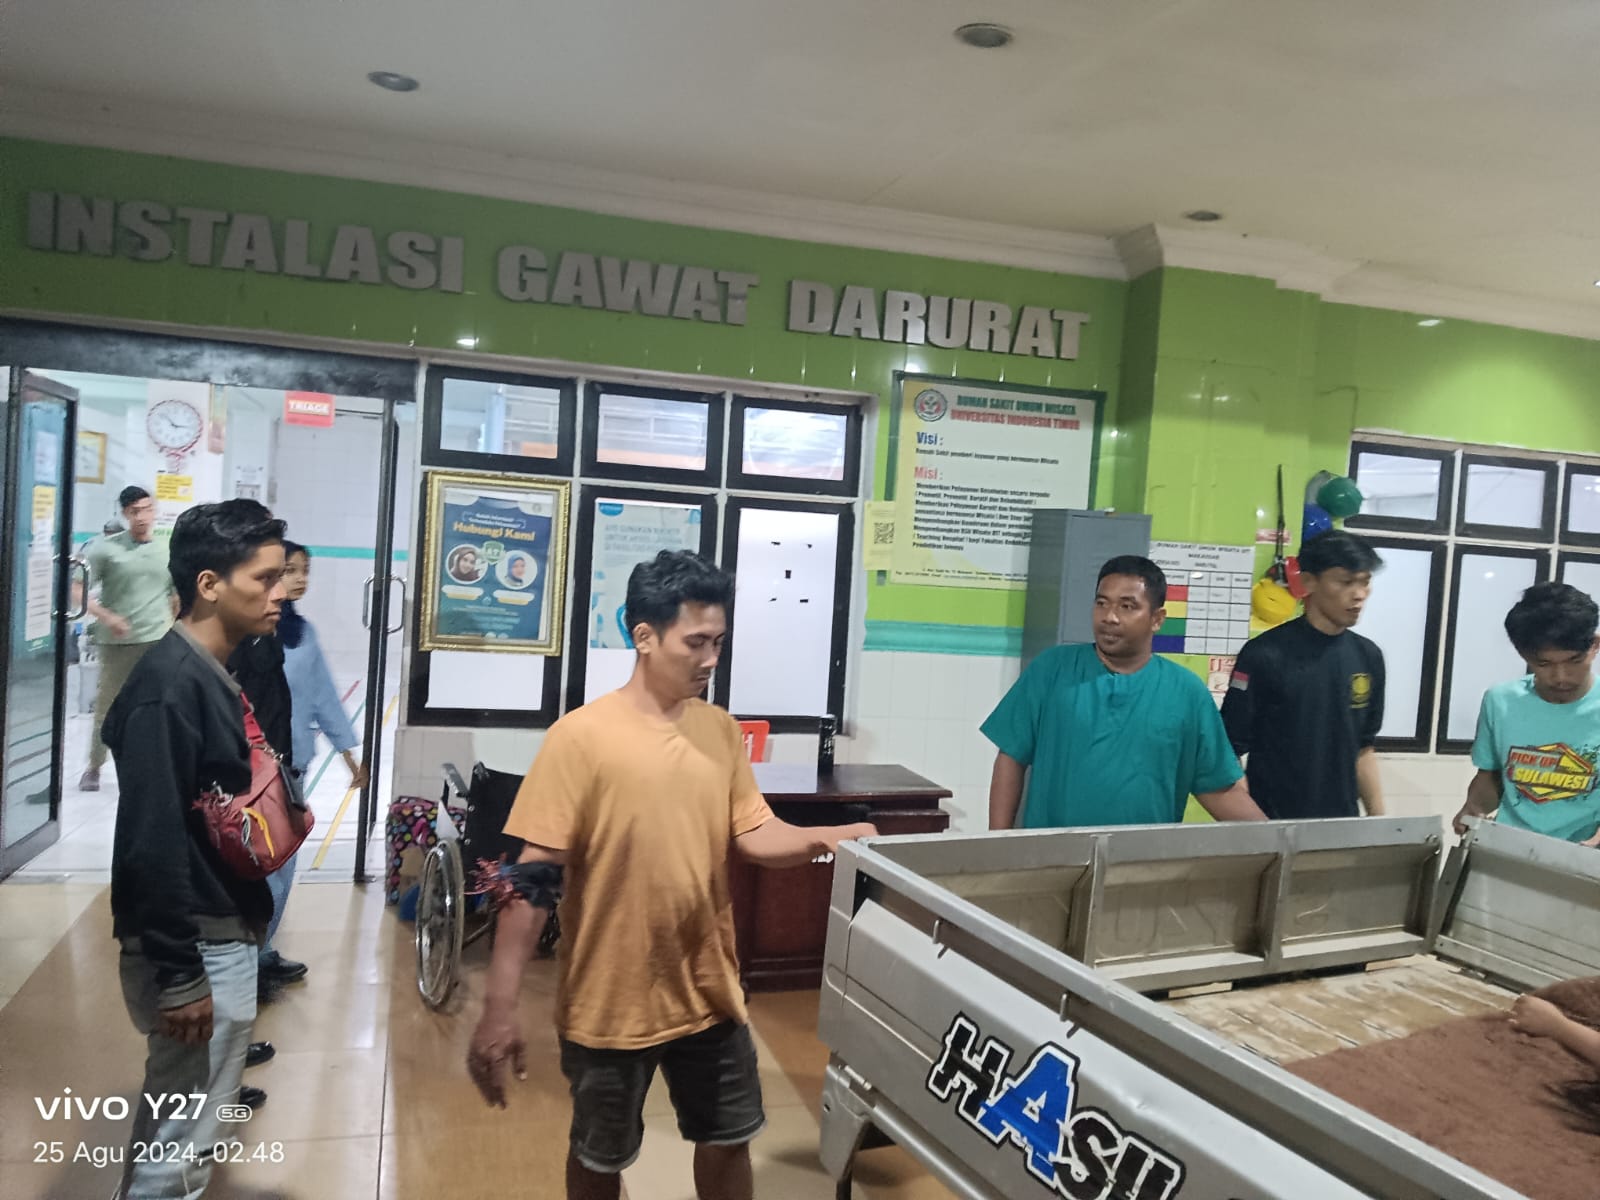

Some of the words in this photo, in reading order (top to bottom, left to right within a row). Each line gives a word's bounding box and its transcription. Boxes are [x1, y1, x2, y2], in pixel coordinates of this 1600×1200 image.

[27, 192, 465, 295] INSTALASI
[498, 245, 759, 326] GAWAT
[787, 279, 1091, 361] DARURAT
[287, 399, 330, 416] TRIAGE
[951, 409, 1005, 425] UNIVERSITAS
[1007, 414, 1052, 429] INDONESIA
[916, 431, 938, 445] Visi
[914, 466, 938, 480] Misi
[452, 521, 503, 539] Hubungi
[504, 528, 536, 542] Kami
[1514, 768, 1591, 790] SULAWESI
